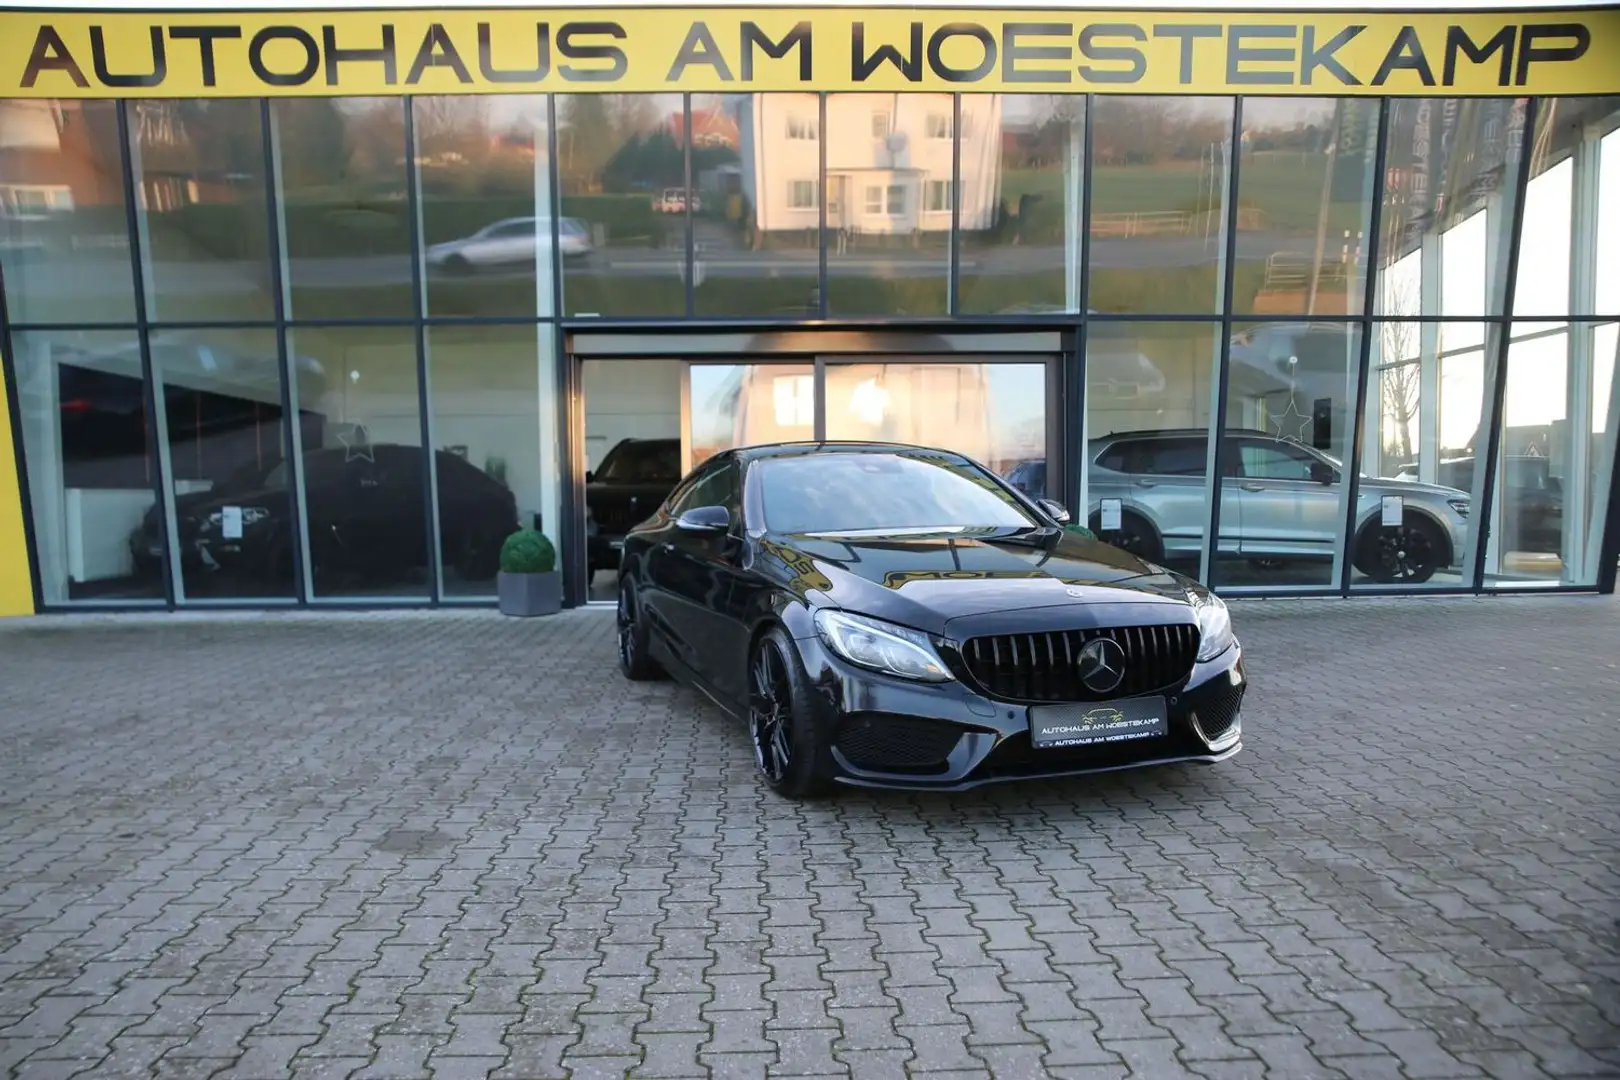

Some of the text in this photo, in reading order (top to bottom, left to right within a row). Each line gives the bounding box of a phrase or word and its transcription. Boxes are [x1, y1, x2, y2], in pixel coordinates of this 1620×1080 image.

[19, 20, 1590, 88] AUTOHAUS AM WOESTEKAMP
[1041, 718, 1159, 734] AUTOHAUS AM WOESTEKAMP
[1106, 732, 1149, 741] WOESTEKAMP
